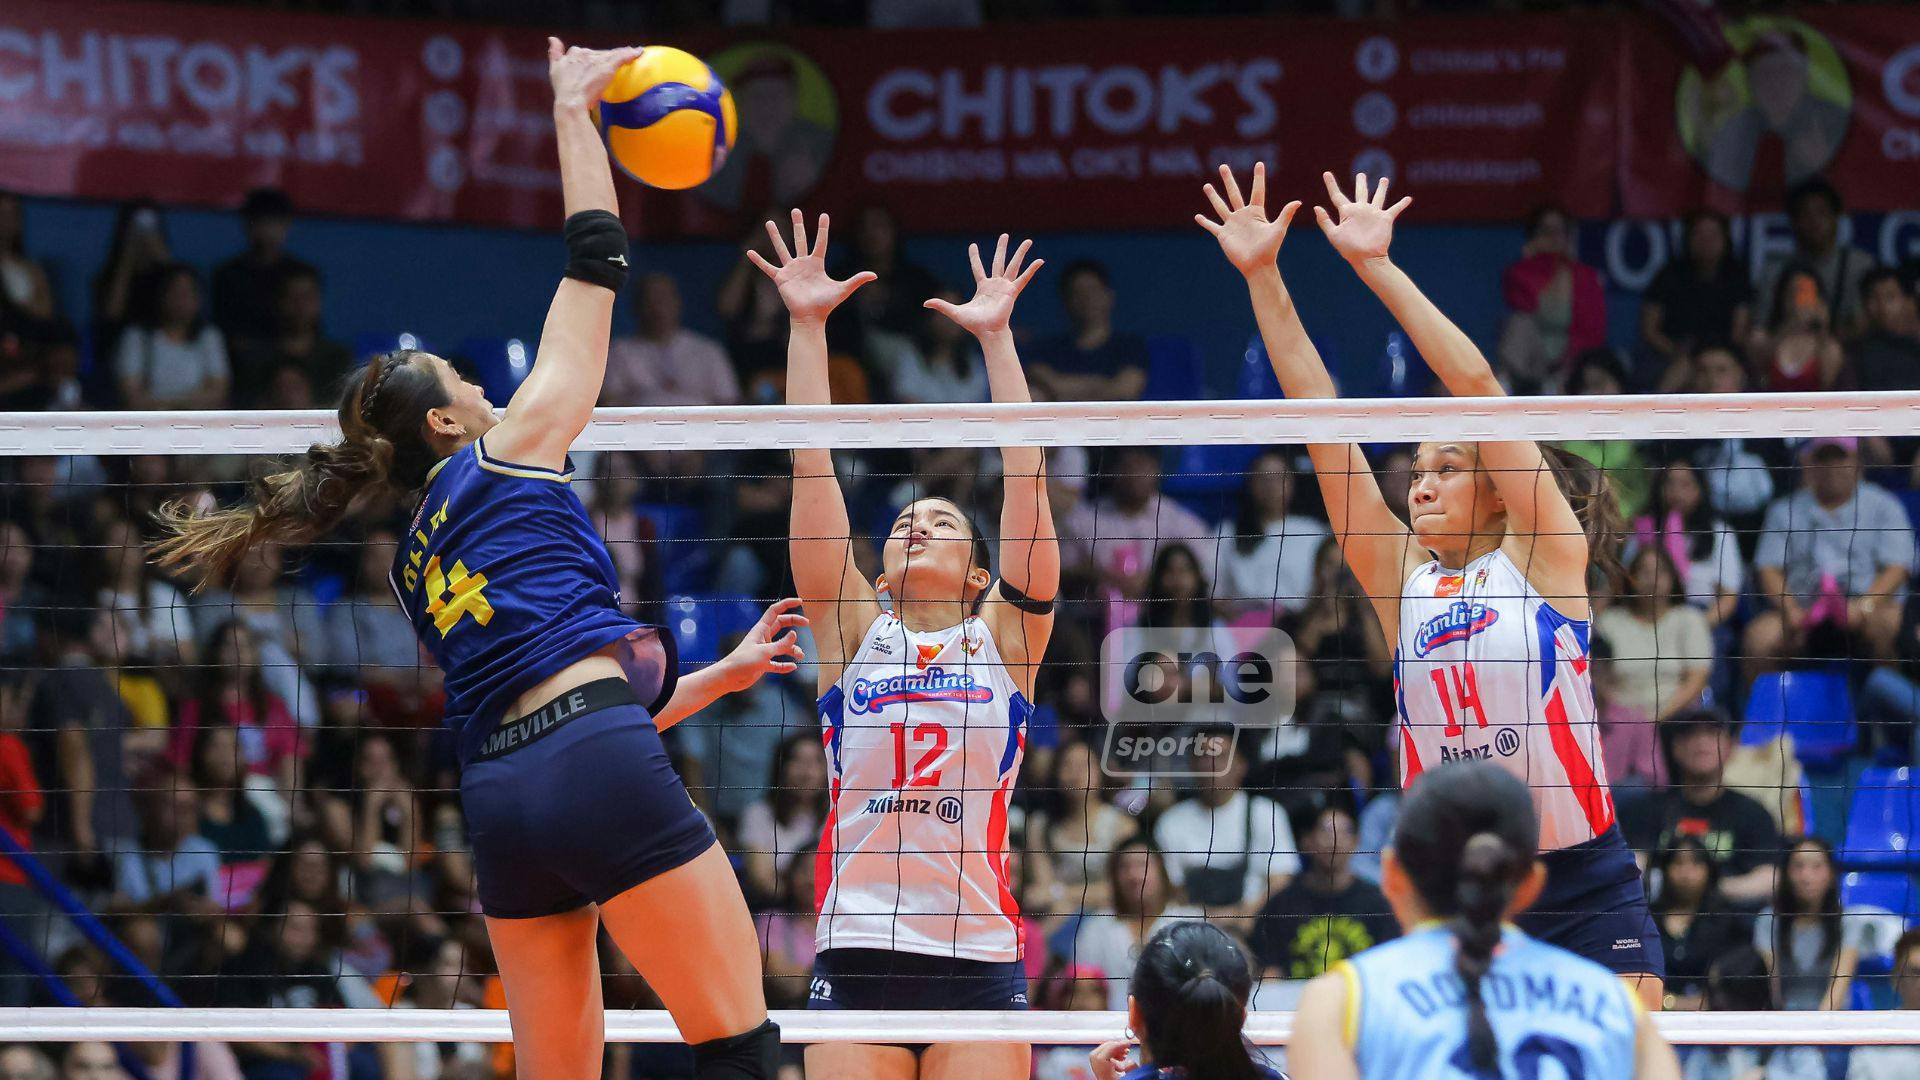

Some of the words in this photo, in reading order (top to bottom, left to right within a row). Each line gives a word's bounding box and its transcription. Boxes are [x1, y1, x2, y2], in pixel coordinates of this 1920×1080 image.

[866, 57, 1283, 139] CHITOK'S
[424, 553, 496, 640] 4
[850, 669, 973, 713] Creamline
[1430, 661, 1489, 738] 14
[889, 722, 949, 789] 12
[862, 797, 931, 816] Allianz
